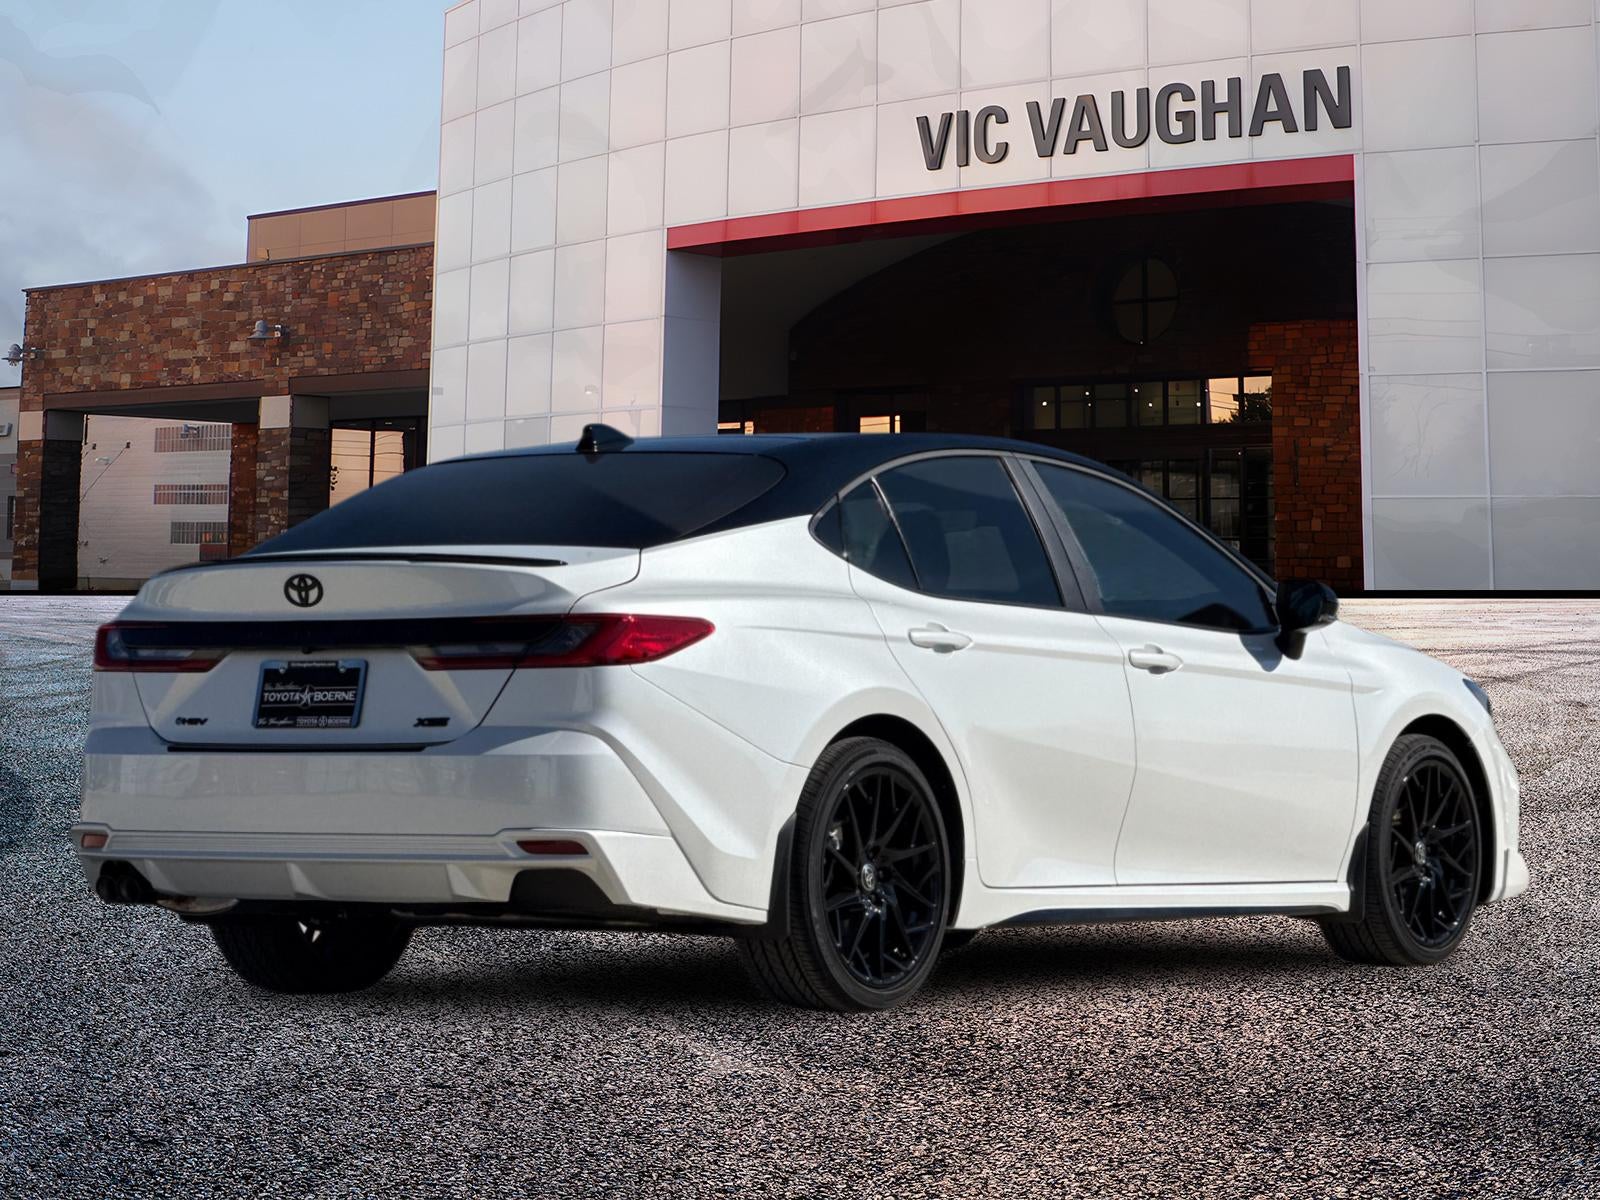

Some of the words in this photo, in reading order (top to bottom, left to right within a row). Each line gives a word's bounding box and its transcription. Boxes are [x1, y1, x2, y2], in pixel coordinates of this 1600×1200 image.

[916, 105, 1009, 170] VIC
[1026, 66, 1352, 158] VAUGHAN
[263, 692, 301, 702] TOYOTA
[313, 691, 356, 701] BOERNE
